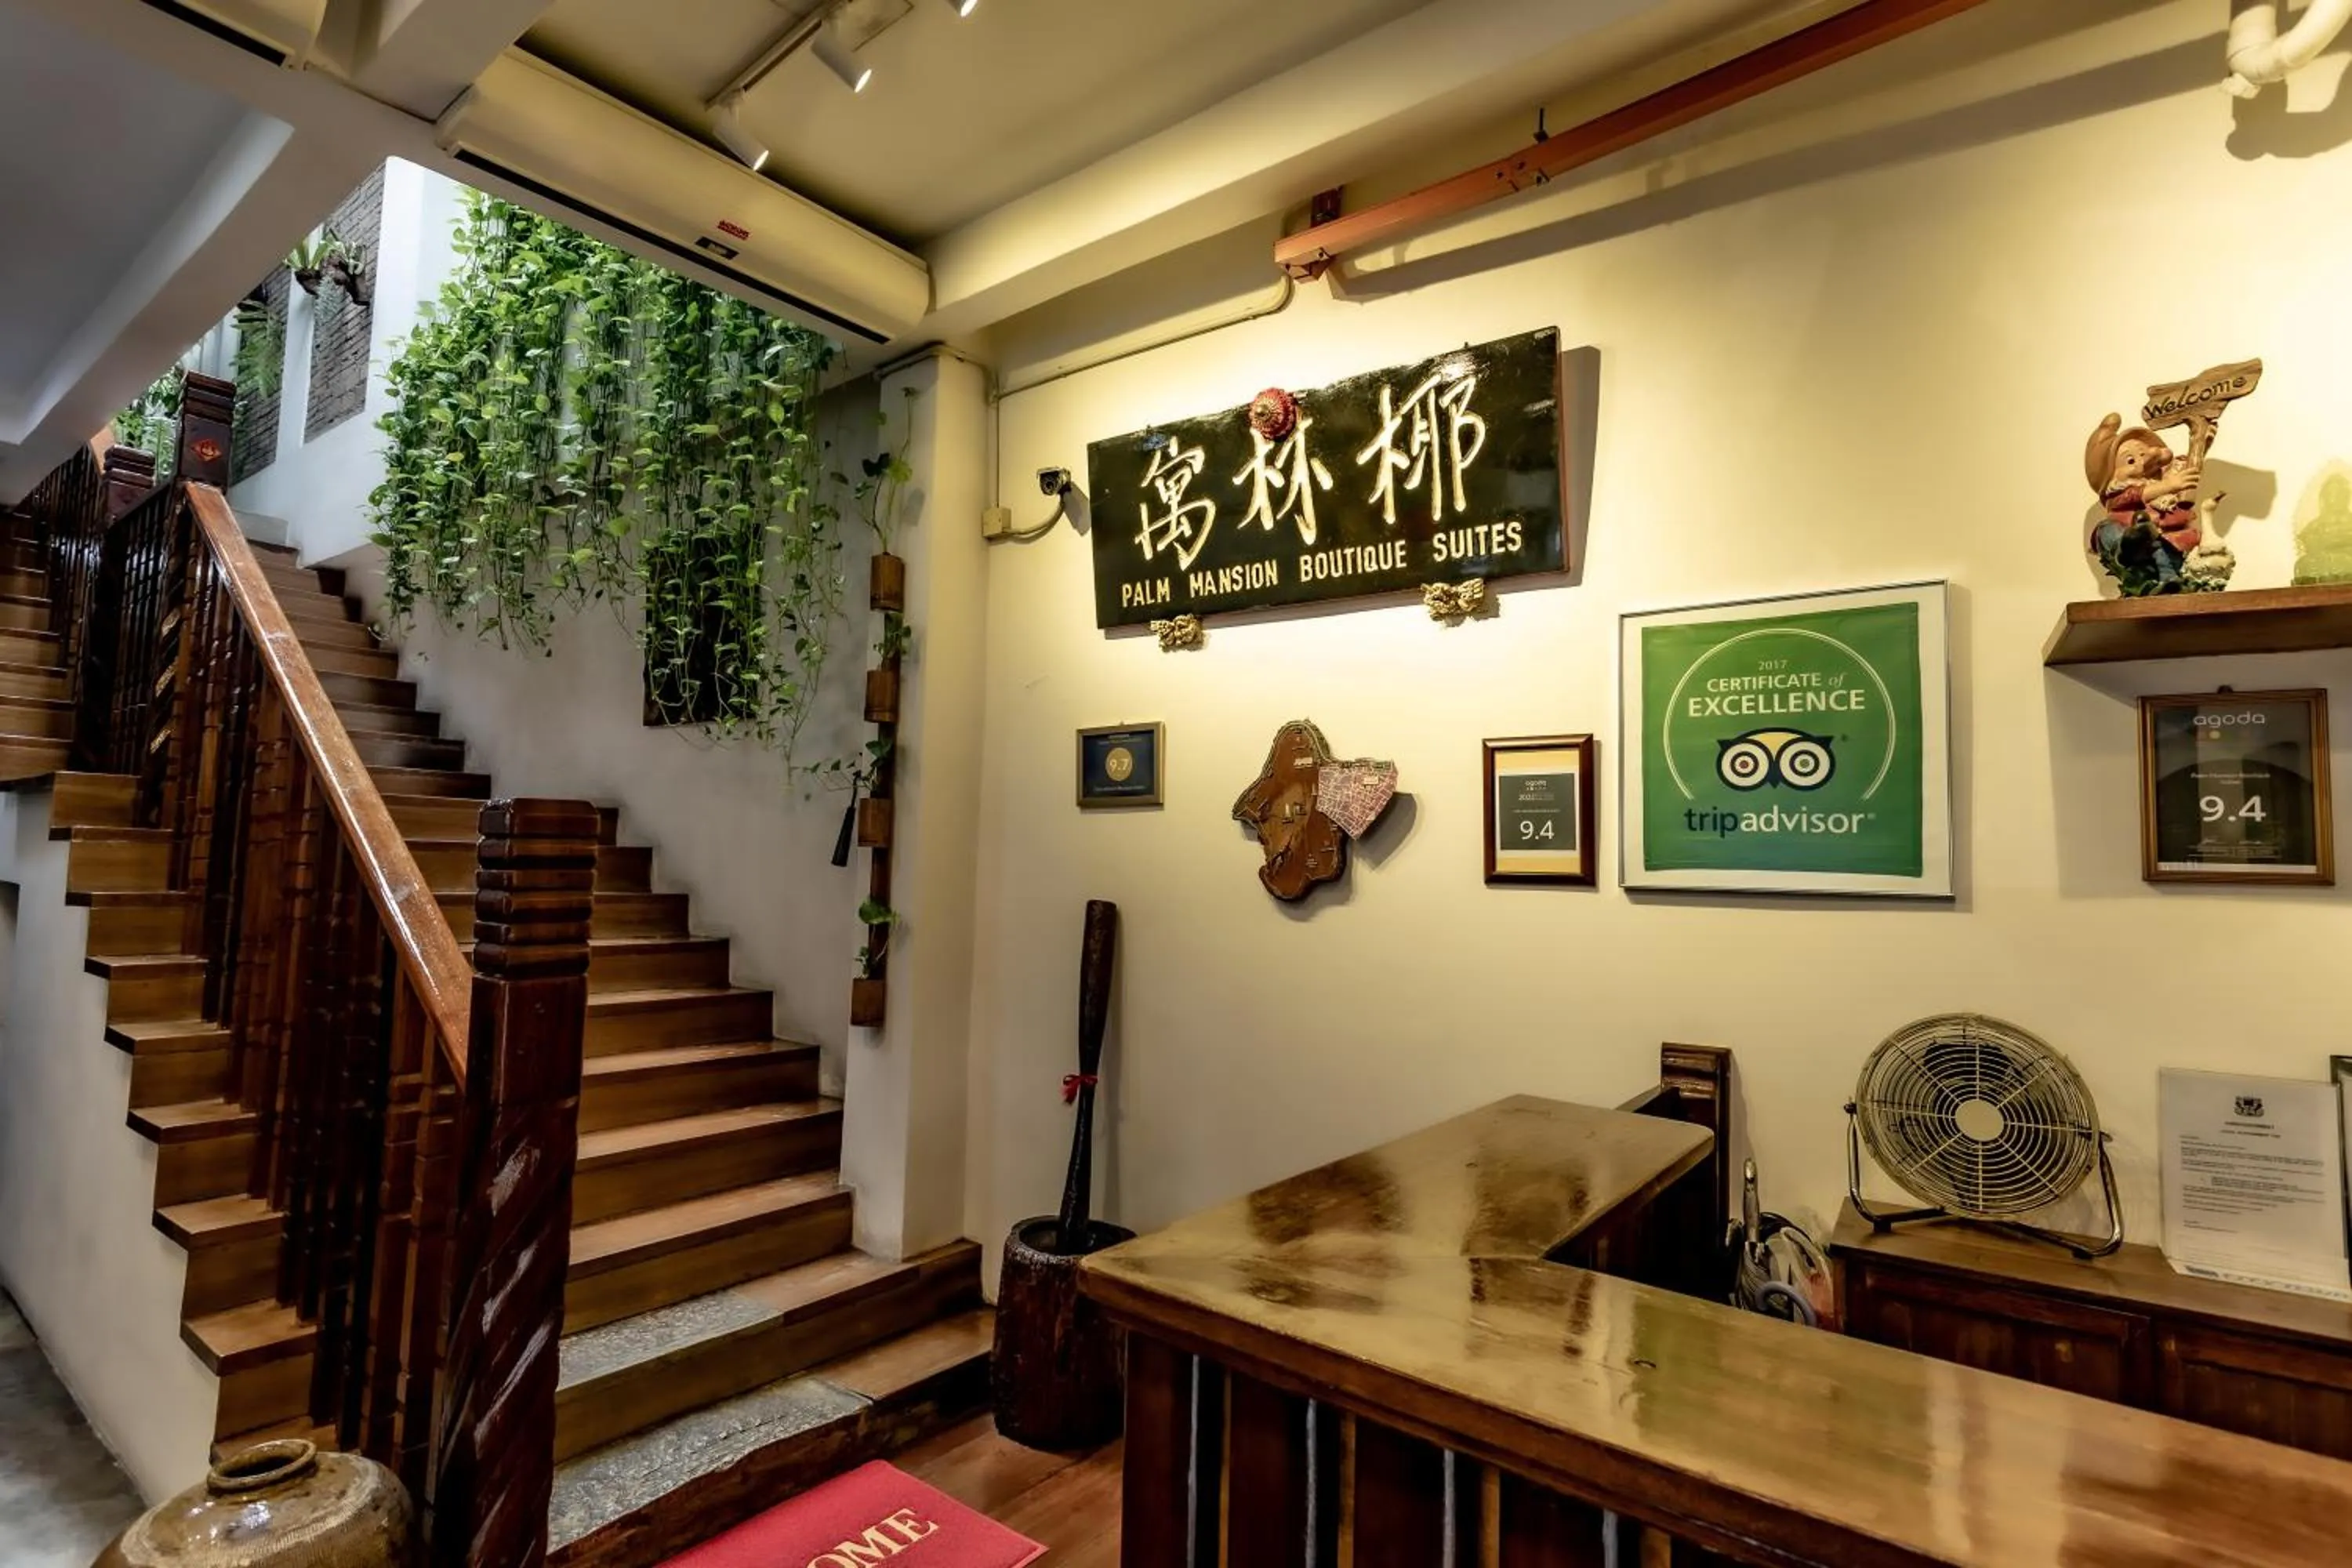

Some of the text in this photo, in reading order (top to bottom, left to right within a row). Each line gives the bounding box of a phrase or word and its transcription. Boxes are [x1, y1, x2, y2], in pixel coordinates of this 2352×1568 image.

[2143, 375, 2248, 419] Welcome
[1121, 521, 1523, 608] PALM MANSION BOUTIQUE SUITES
[1758, 659, 1788, 672] 2017
[1706, 672, 1848, 693] CERTIFICATE of
[1687, 688, 1867, 718] EXCELLENCE
[2193, 711, 2267, 728] agoda
[1683, 804, 1865, 839] tripadvisor
[2199, 795, 2267, 822] 9.4
[1519, 819, 1555, 840] 9.4
